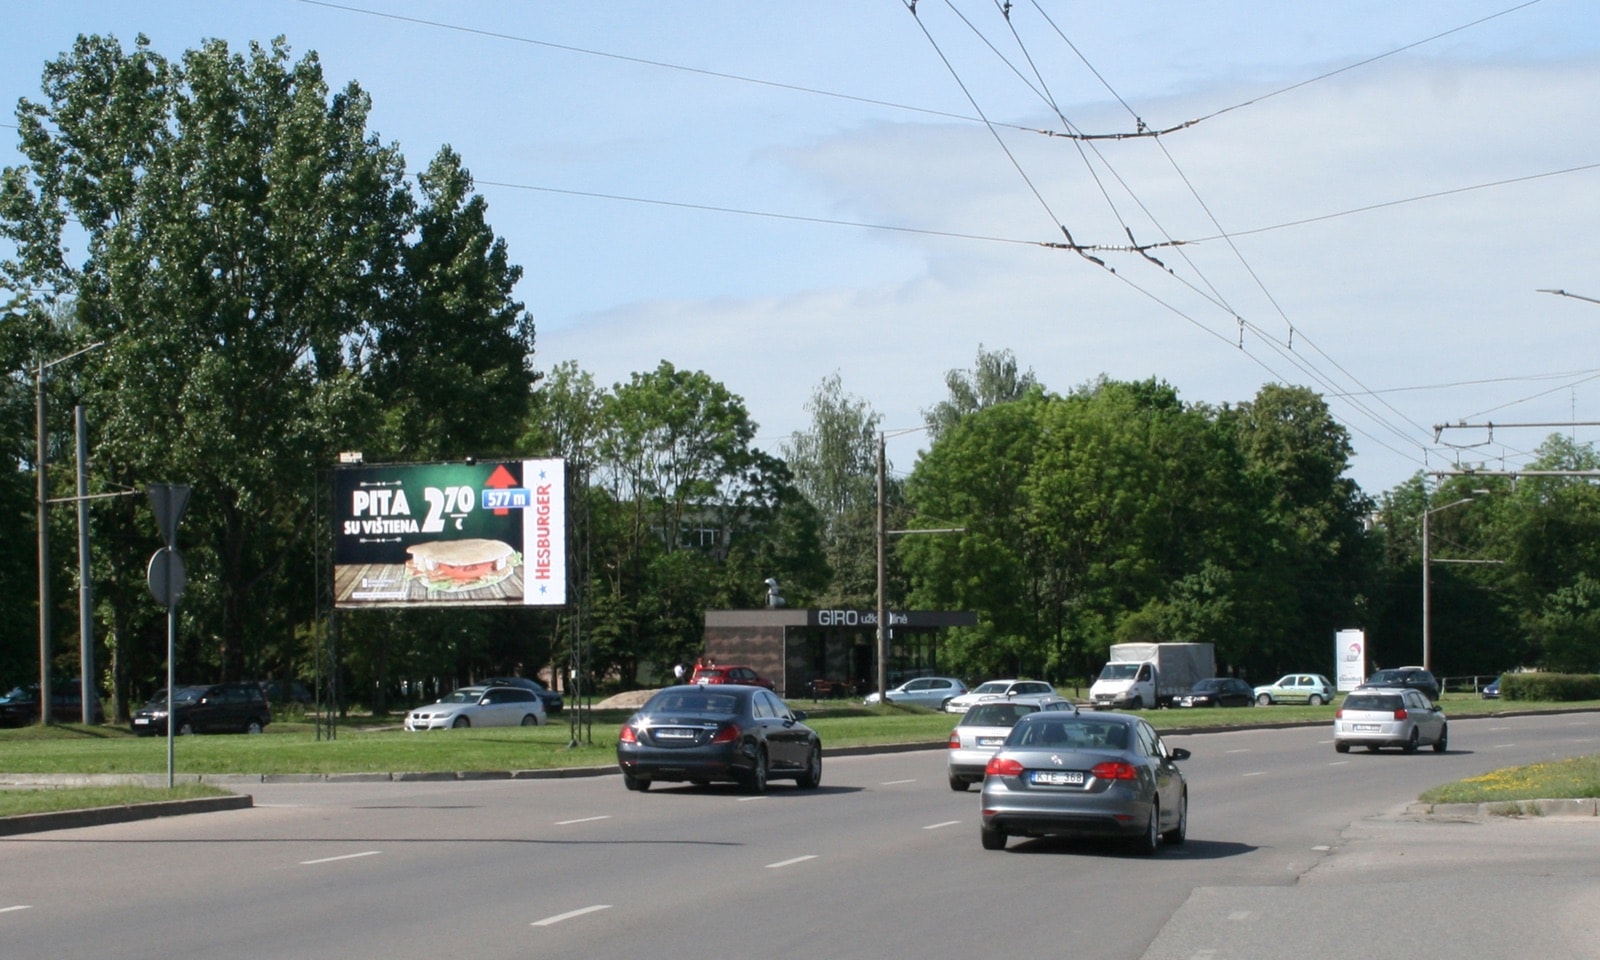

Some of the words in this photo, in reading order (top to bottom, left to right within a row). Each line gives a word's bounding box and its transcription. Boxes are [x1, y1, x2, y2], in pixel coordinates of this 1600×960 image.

[352, 489, 411, 516] PITA
[488, 491, 511, 506] 577
[513, 493, 526, 505] m
[344, 520, 361, 535] SU
[361, 516, 420, 535] VIŠTIENA
[535, 483, 551, 580] HESBURGER
[818, 610, 858, 625] GIRO
